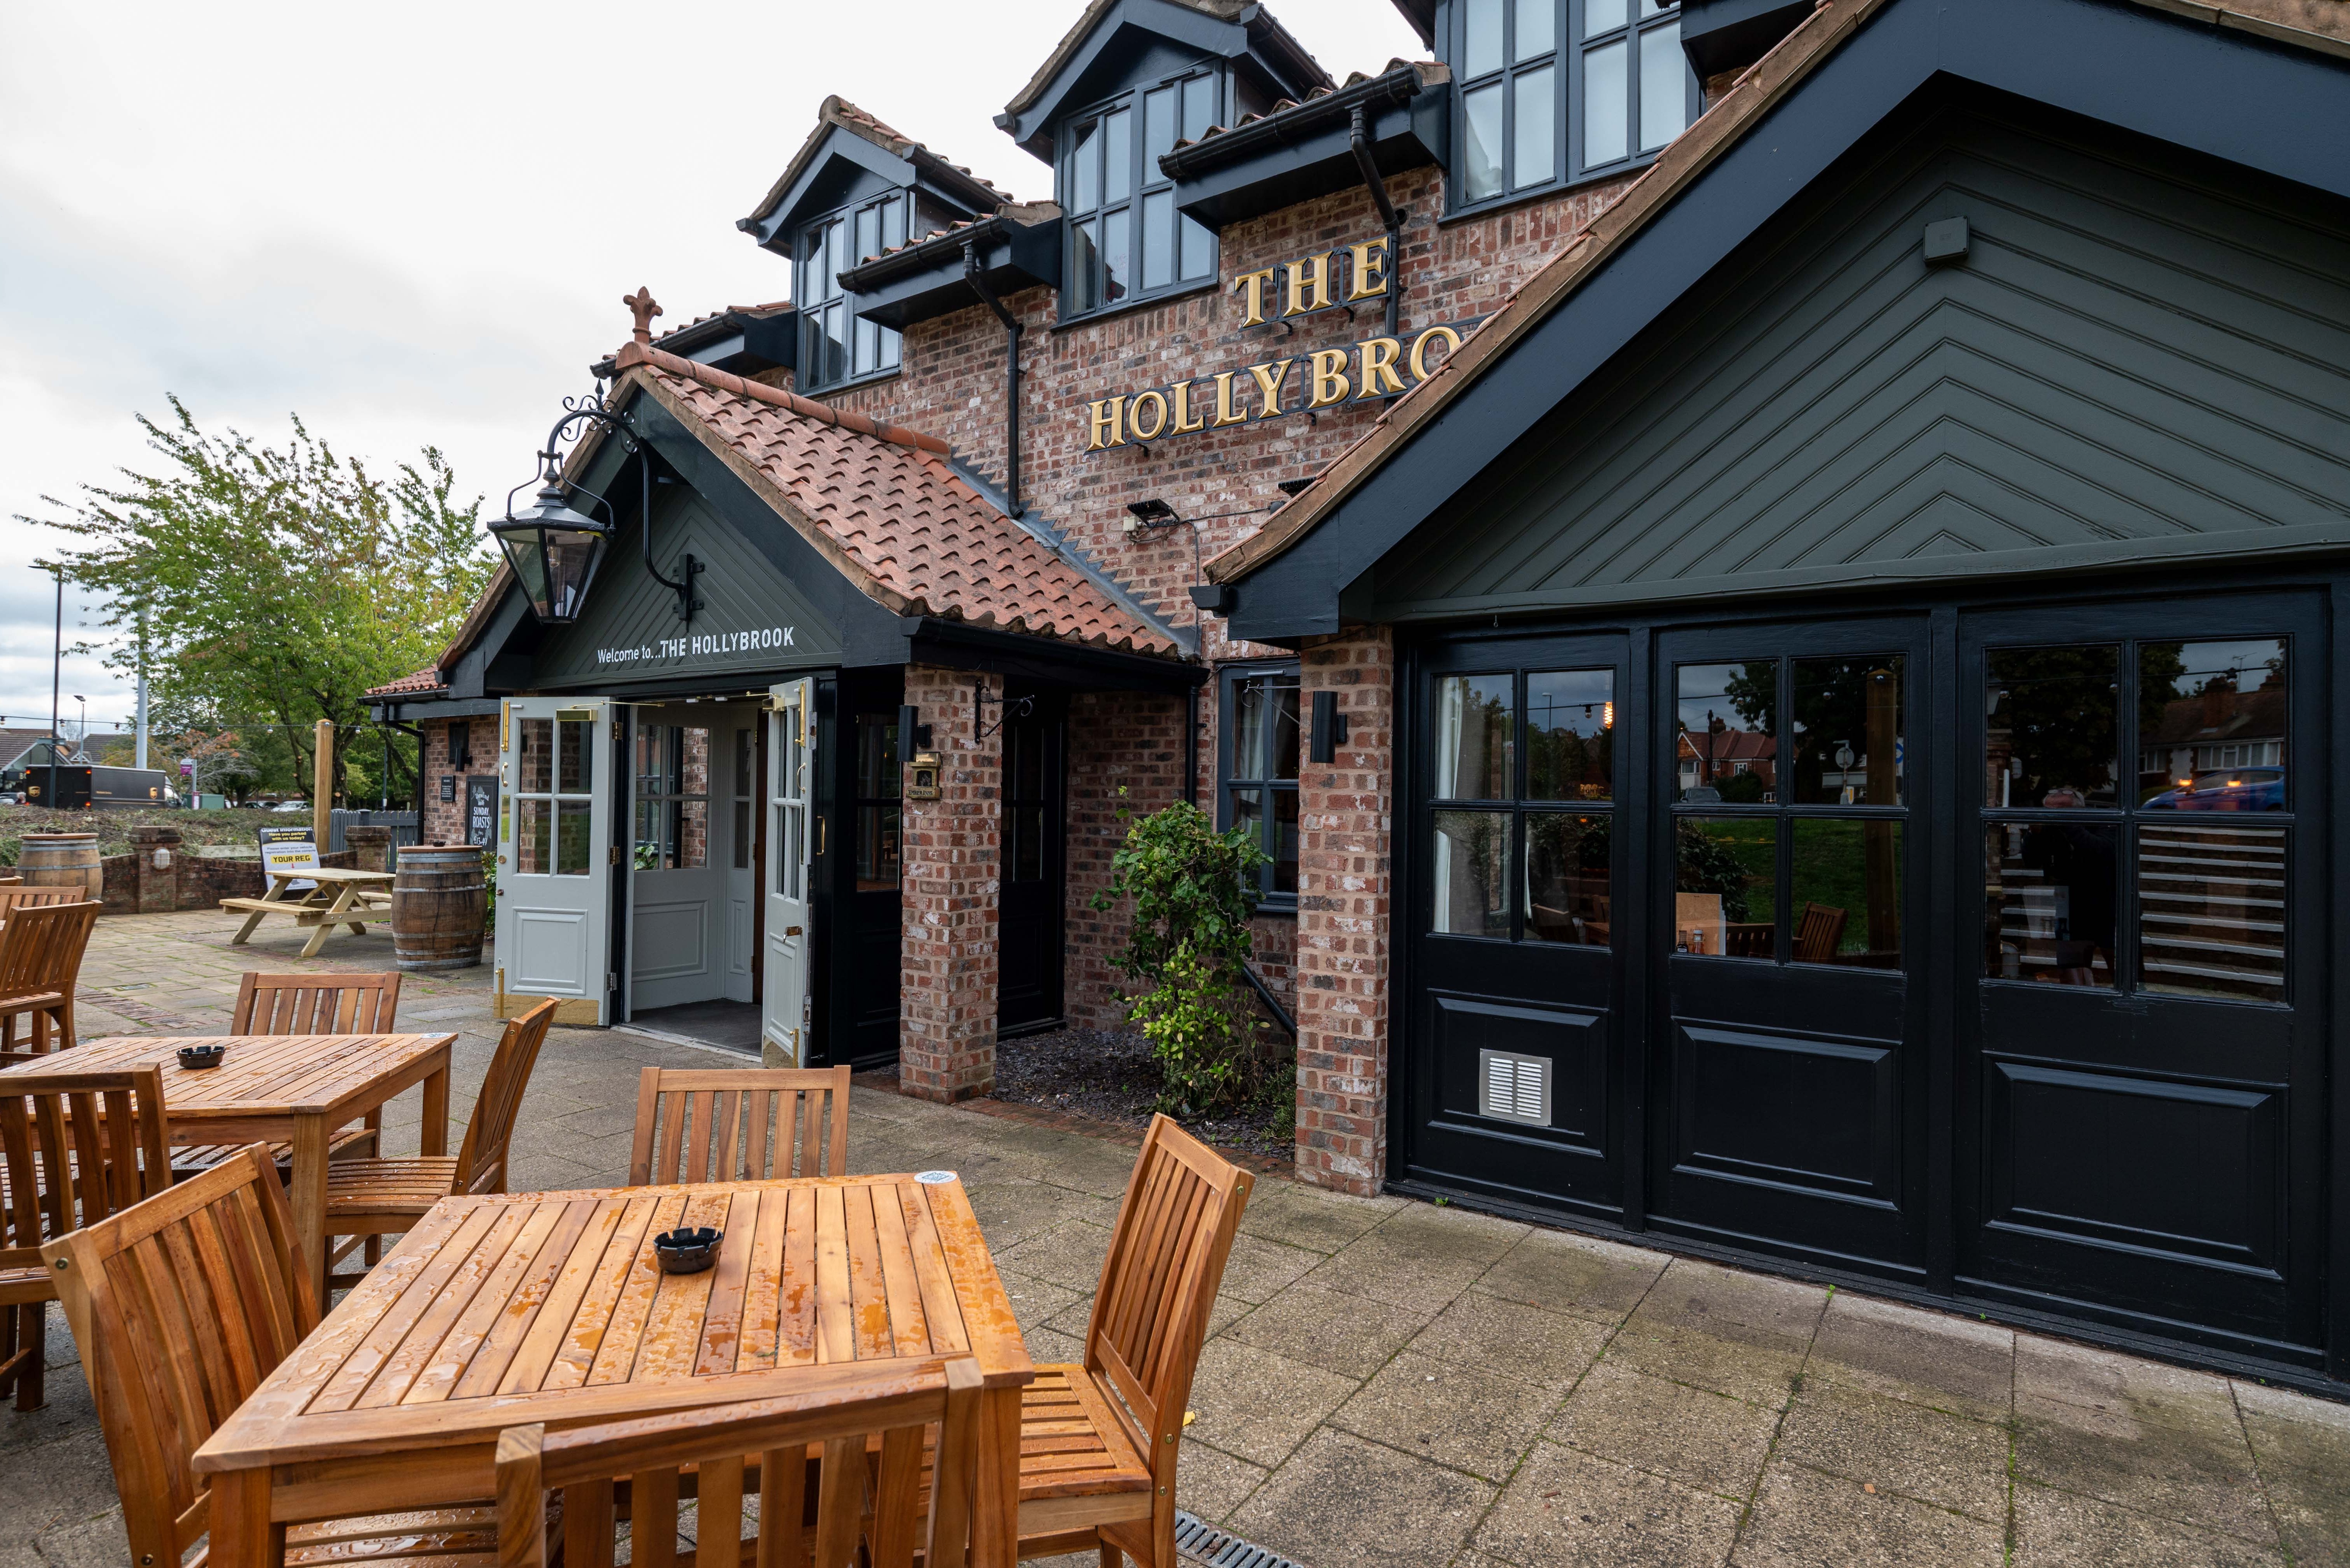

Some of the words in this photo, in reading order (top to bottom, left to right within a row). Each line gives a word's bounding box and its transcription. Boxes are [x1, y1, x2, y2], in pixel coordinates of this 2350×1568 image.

[1235, 236, 1388, 328] THE
[1087, 315, 1494, 451] HOLLYBRO
[598, 648, 639, 664] Welcome
[660, 637, 687, 658] THE
[692, 627, 794, 655] HOLLYBROOK
[475, 791, 489, 802] Unwind
[473, 806, 489, 816] SUNDAY
[473, 816, 490, 828] ROASTS
